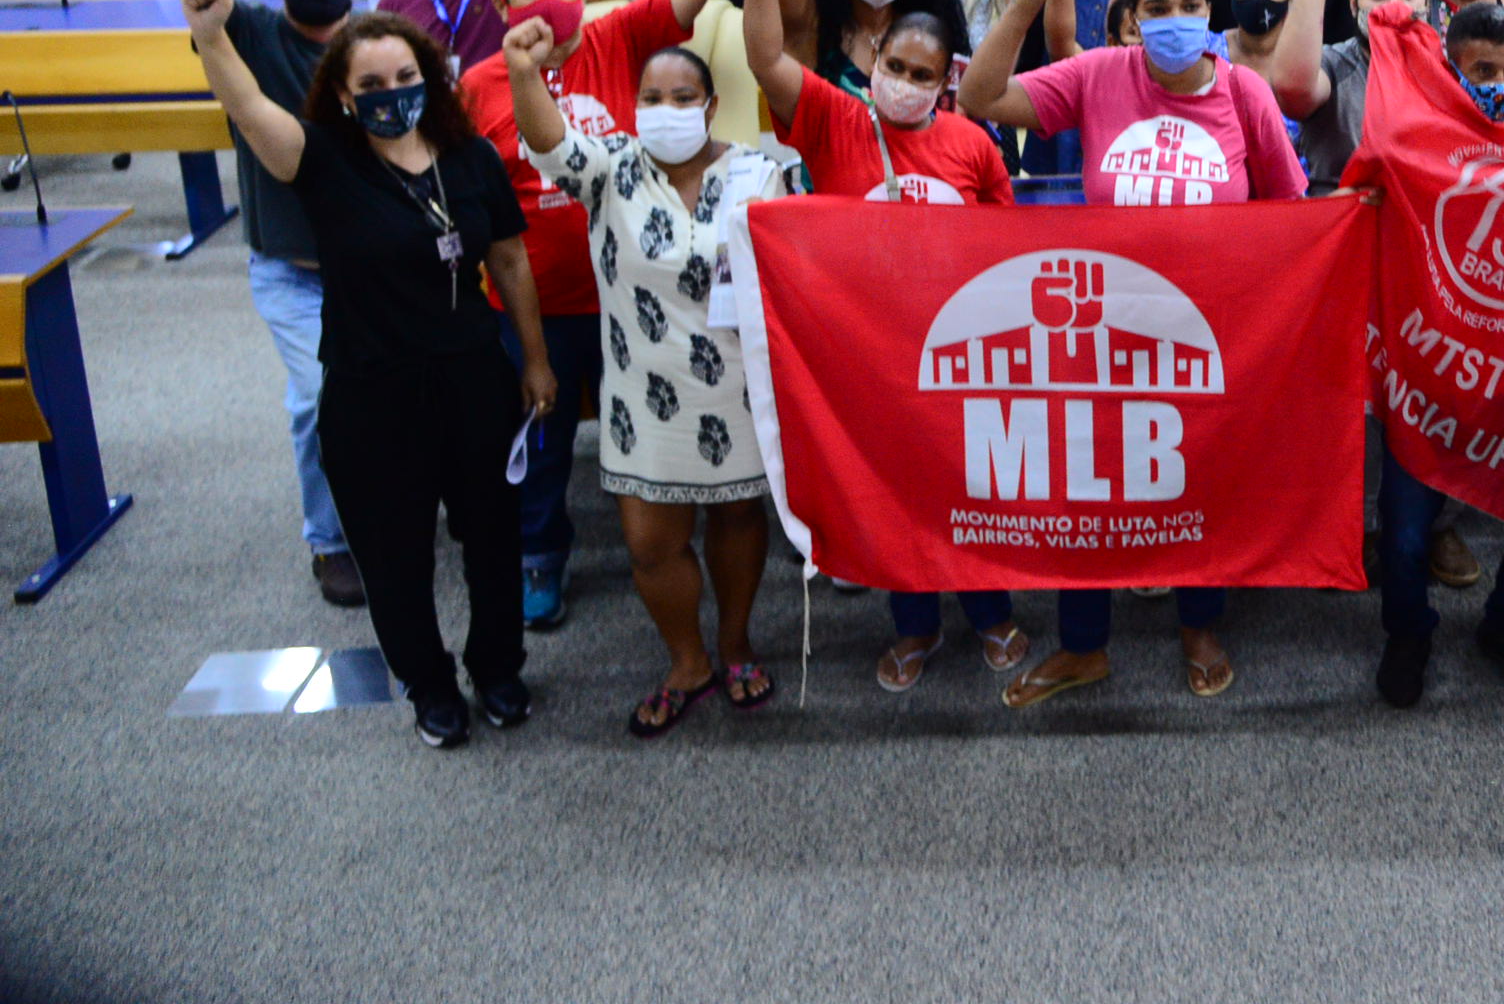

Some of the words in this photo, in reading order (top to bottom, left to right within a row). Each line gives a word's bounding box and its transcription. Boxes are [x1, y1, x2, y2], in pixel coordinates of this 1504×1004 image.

[963, 398, 1186, 502] MLB
[950, 508, 1072, 533] MOVIMENTO
[1079, 516, 1102, 533] DE
[1109, 516, 1157, 533] LUTA
[1163, 509, 1205, 529] NOS
[953, 527, 1040, 549] BAIRROS,
[1046, 534, 1099, 549] VILAS
[1105, 534, 1114, 548] E
[1122, 526, 1203, 547] FAVELAS
